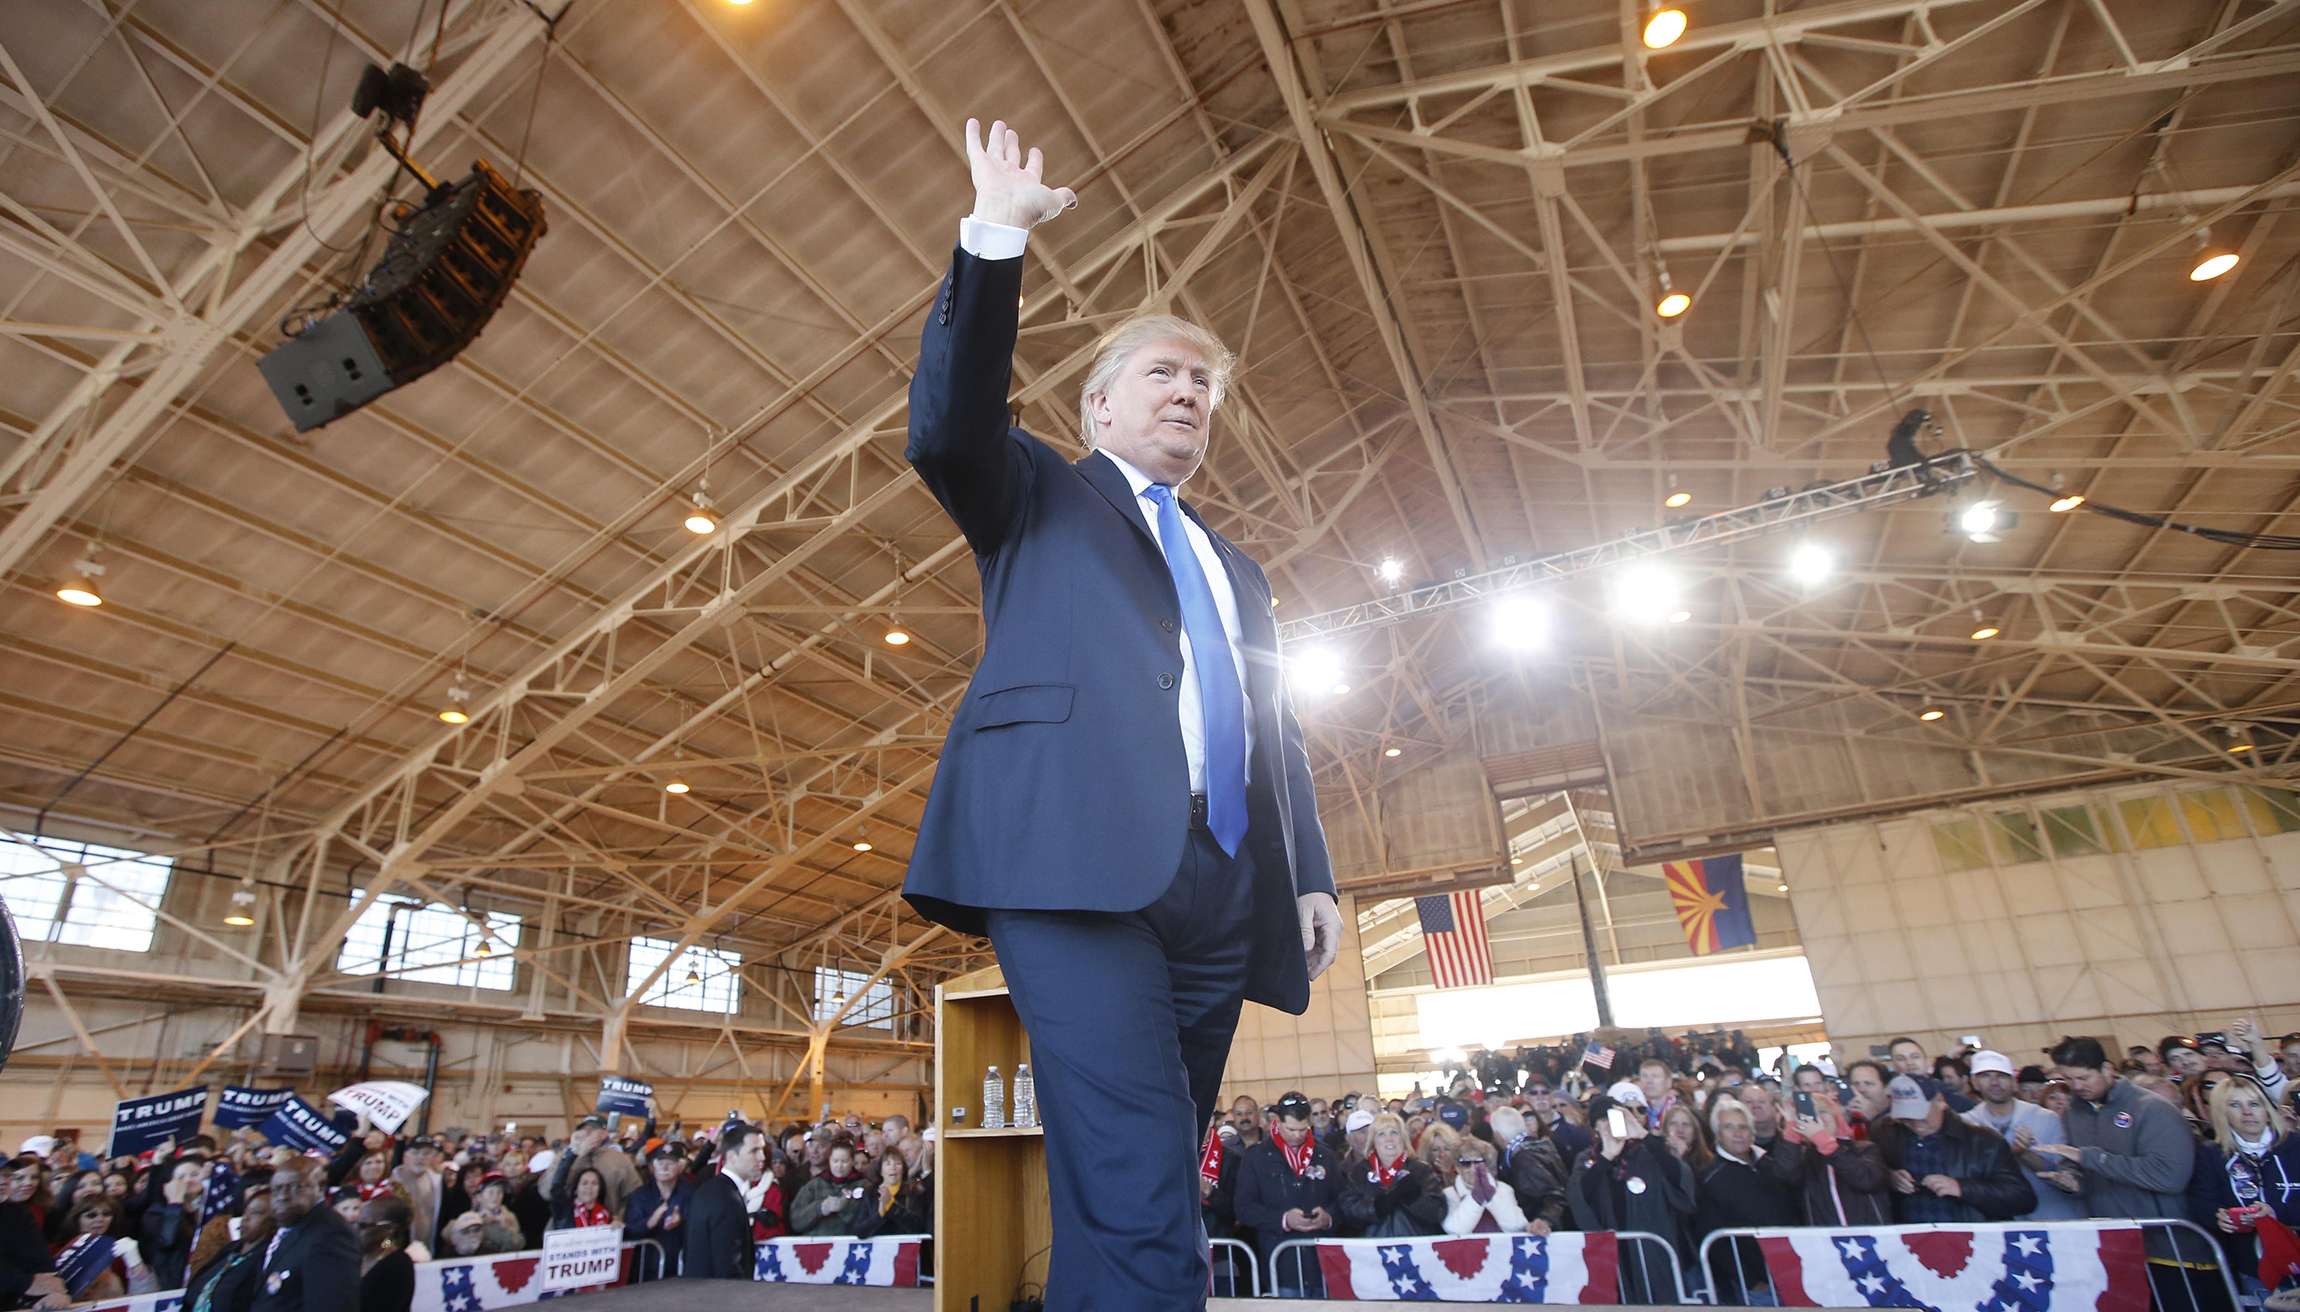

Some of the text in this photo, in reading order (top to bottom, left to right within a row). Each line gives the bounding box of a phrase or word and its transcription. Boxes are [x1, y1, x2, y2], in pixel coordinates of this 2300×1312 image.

[222, 1089, 294, 1106] TRUMP
[603, 1079, 653, 1095] TRUMP
[117, 1091, 208, 1122] TRUMP
[343, 1089, 400, 1120] TRUMP
[284, 1099, 347, 1145] TRUMP
[549, 1246, 616, 1261] STANDS WITH
[548, 1258, 615, 1280] TRUMP
